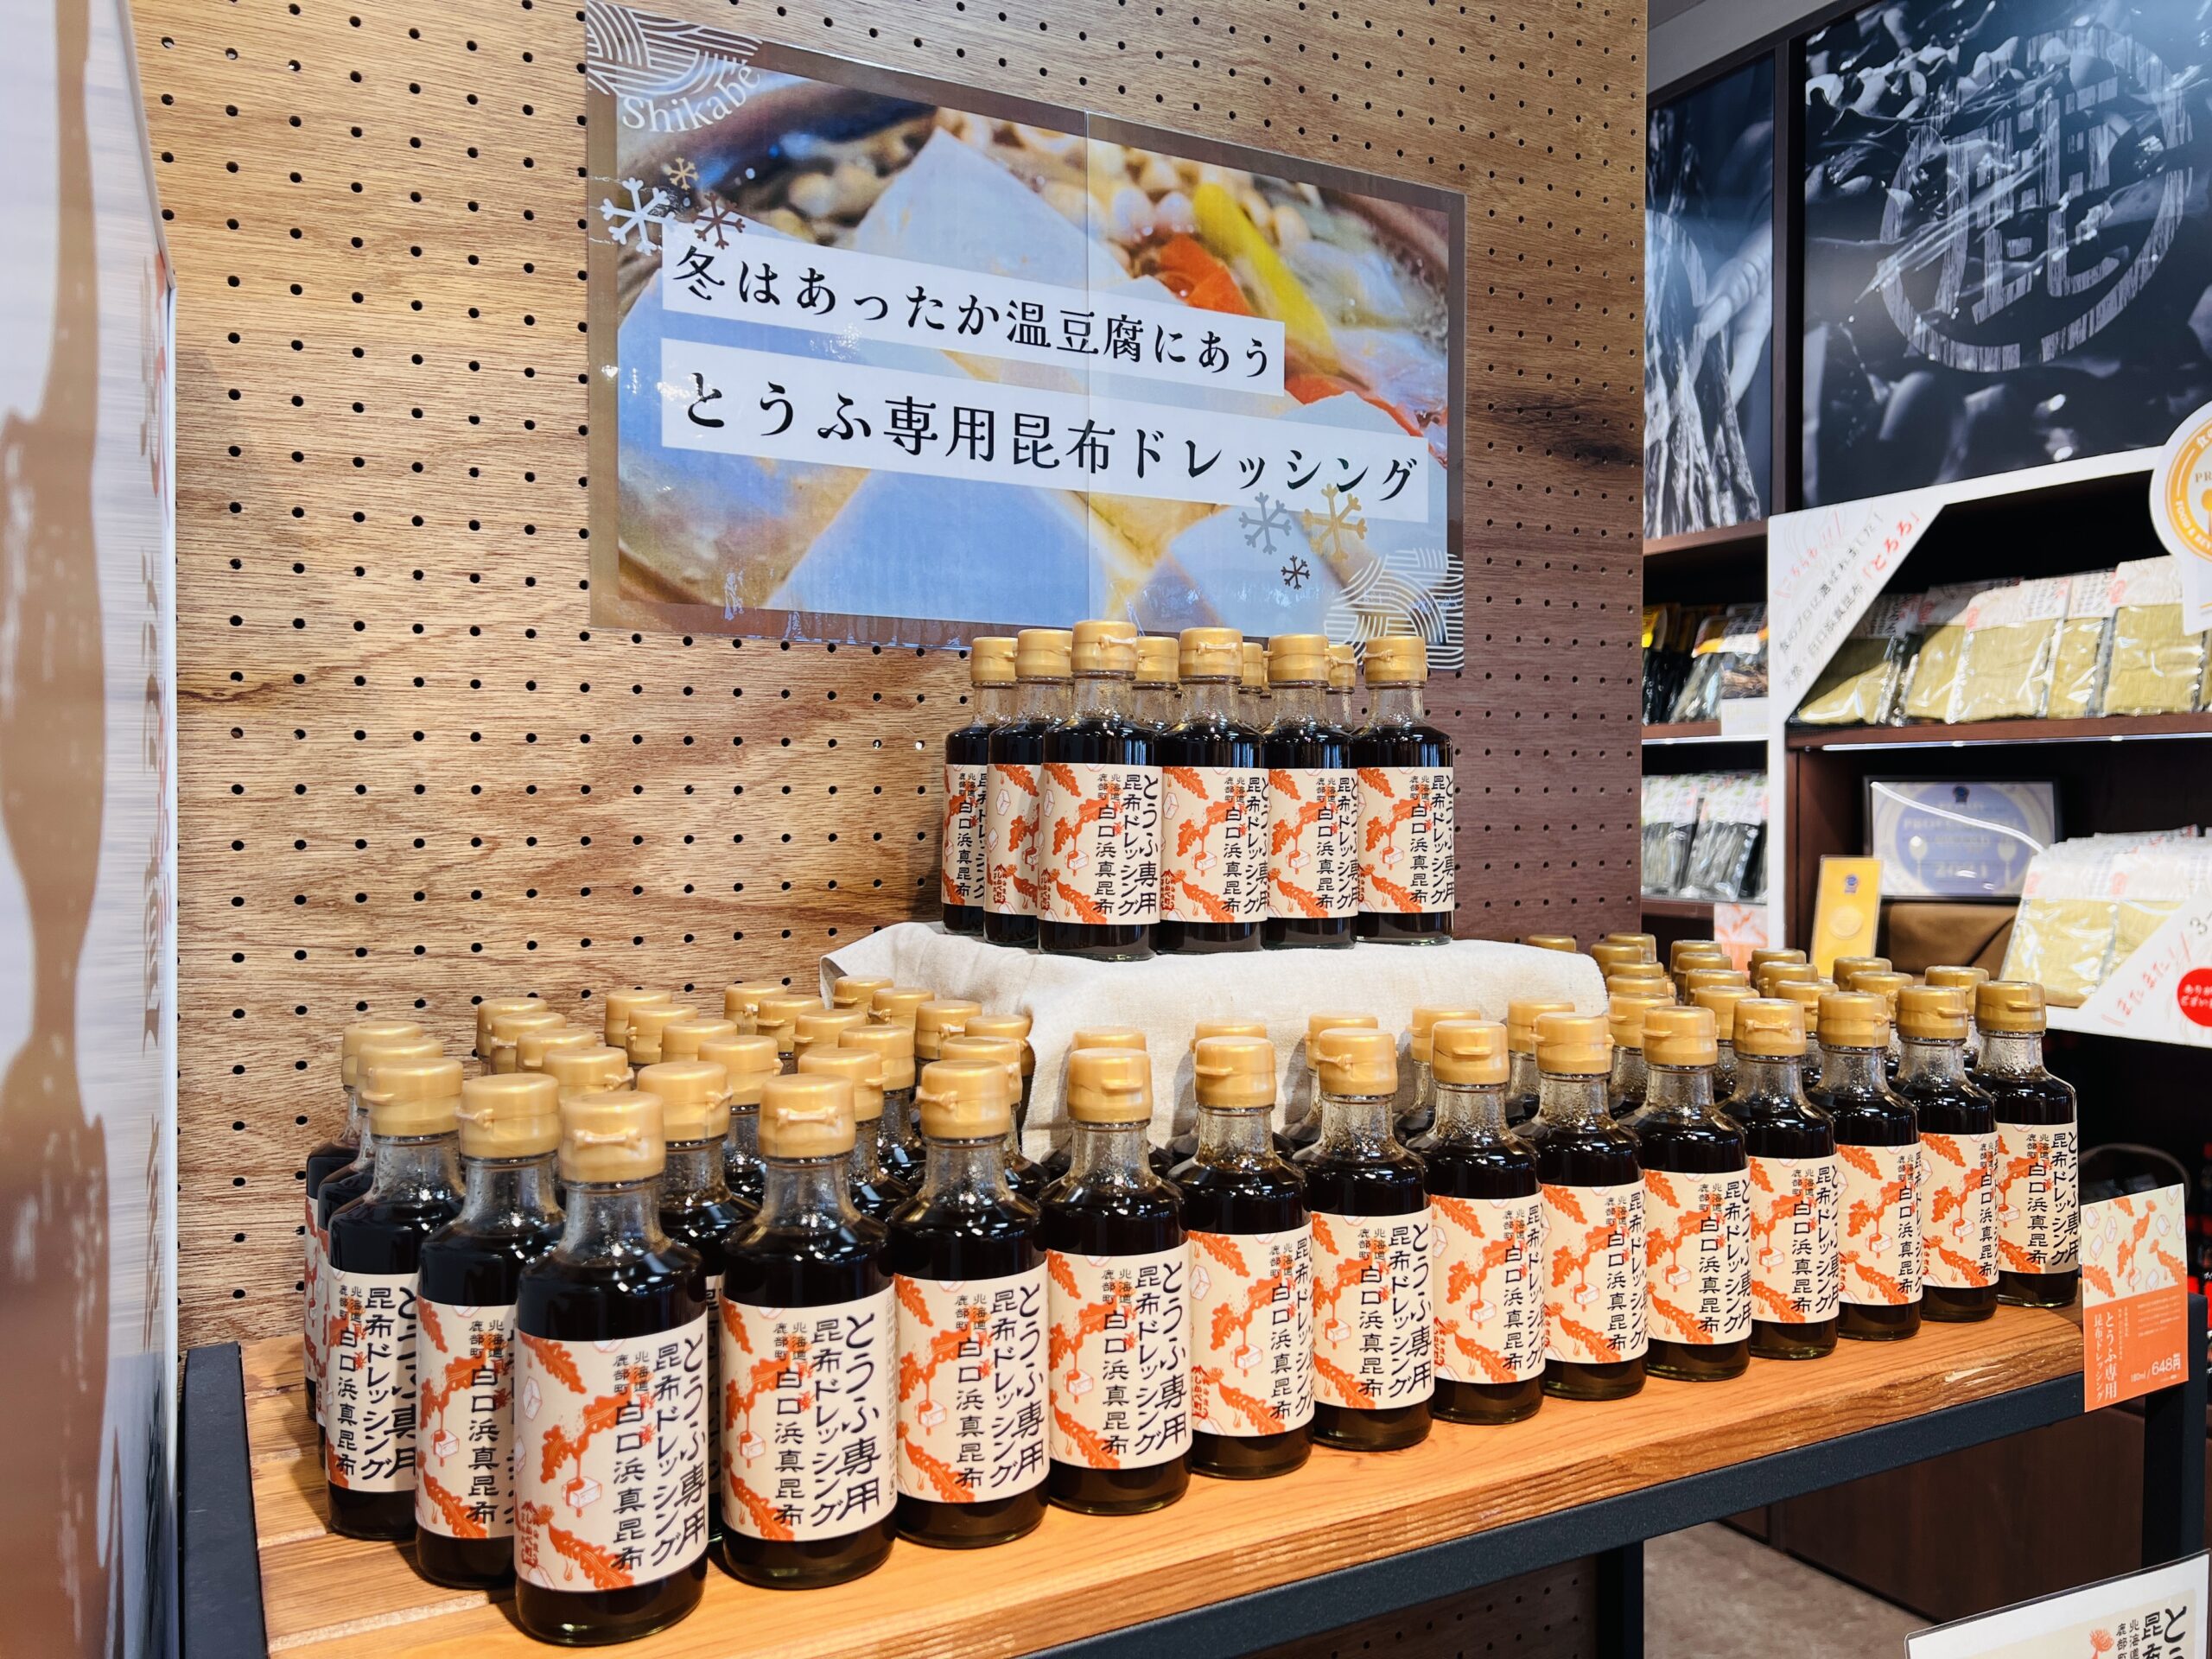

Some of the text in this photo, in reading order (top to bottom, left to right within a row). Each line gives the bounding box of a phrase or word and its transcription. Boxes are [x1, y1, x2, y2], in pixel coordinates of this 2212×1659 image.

[672, 245, 1268, 378] 冬はあったか温豆腐にあう
[688, 372, 1418, 501] とうふ専用昆布ドレッシング
[1092, 804, 1117, 914] 白口浜真昆布
[1118, 773, 1142, 917] 昆布ドレッシング
[1134, 775, 1158, 914] とうふ専用
[1222, 807, 1243, 913] 白口浜真昆布
[1244, 777, 1262, 914] 昆布ドレッシング
[1315, 806, 1335, 909] 白口浜真昆布
[1337, 777, 1351, 910] 昆布ドレッシング
[1409, 804, 1428, 903] 白口浜真昆布
[1431, 775, 1446, 905] 昆布ドレッシング
[1723, 1180, 1741, 1334] 昆布ドレッシング
[1790, 1200, 1813, 1313] 白口浜真昆布
[1815, 1166, 1832, 1313] 昆布ドレッシング
[2026, 1162, 2048, 1265] 白口浜真昆布
[2050, 1134, 2069, 1266] 昆布ドレッシング
[1357, 1265, 1385, 1397] 白口浜真昆布
[1389, 1225, 1412, 1398] 昆布ドレッシング
[1407, 1223, 1432, 1395] とうふ専用
[1503, 1245, 1524, 1371] 白口浜真昆布
[1606, 1230, 1628, 1351] 白口浜真昆布
[1697, 1217, 1721, 1333] 白口浜真昆布
[335, 1327, 359, 1476] 白口浜真昆布
[361, 1287, 396, 1481] 昆布ドレッシング
[810, 1318, 843, 1528] 昆布ドレッシング
[835, 1312, 881, 1522] とうふ専用
[955, 1337, 985, 1489] 白口浜真昆布
[989, 1289, 1018, 1488] 昆布ドレッシング
[1010, 1283, 1045, 1482] とうふ専用
[1101, 1310, 1130, 1456] 白口浜真昆布
[1135, 1265, 1161, 1456] 昆布ドレッシング
[1154, 1261, 1187, 1451] とうふ専用
[1269, 1282, 1293, 1420] 白口浜真昆布
[2104, 1311, 2117, 1402] とうふ専用
[466, 1365, 500, 1524] 白口浜真昆布
[611, 1401, 646, 1571] 白口浜真昆布
[651, 1342, 682, 1567] 昆布ドレッシング
[675, 1332, 706, 1556] とうふ専用
[773, 1368, 805, 1527] 白口浜真昆布
